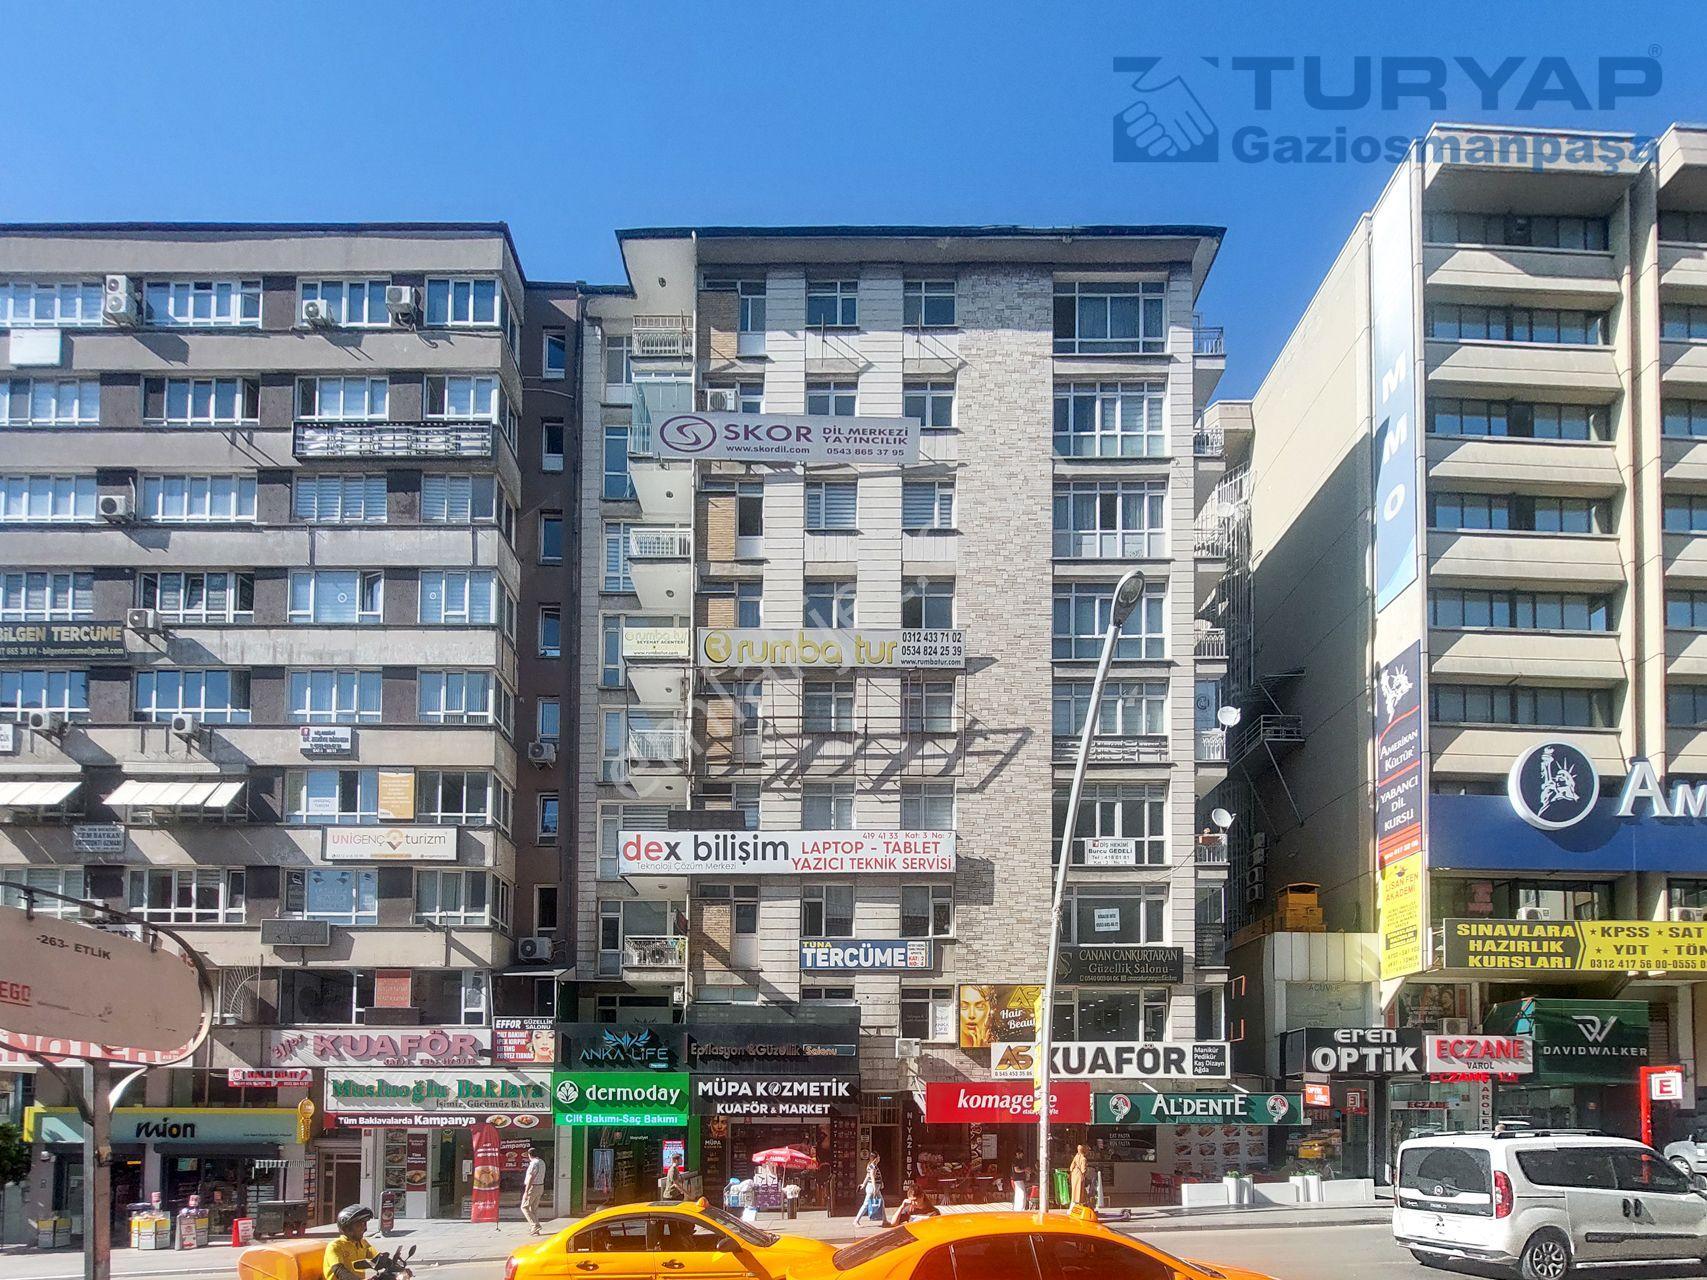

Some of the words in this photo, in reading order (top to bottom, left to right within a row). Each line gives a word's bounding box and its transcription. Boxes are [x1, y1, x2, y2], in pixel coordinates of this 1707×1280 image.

[724, 424, 813, 443] SKOR
[822, 436, 908, 445] YAYINCILIK
[726, 445, 810, 454] www.skordil.com
[51, 625, 122, 642] TERCÜME
[635, 629, 671, 640] rumba
[902, 632, 921, 643] 0312
[923, 632, 938, 642] 433
[940, 632, 949, 642] 71
[951, 632, 962, 642] 02
[737, 631, 842, 664] rumba
[855, 634, 897, 664] tur
[901, 646, 921, 656] 0534
[923, 646, 938, 656] 824
[940, 646, 950, 656] 25
[951, 646, 962, 656] 39
[901, 658, 962, 666] www.rumbatur.com
[1380, 774, 1419, 804] YABANCI
[1384, 808, 1414, 832] KURSU
[405, 833, 446, 845] turizm
[622, 834, 682, 862] dex
[693, 834, 789, 866] bilişim
[801, 841, 864, 855] LAPTOP
[883, 841, 941, 855] TABLET
[637, 862, 672, 871] Teknoloji
[674, 861, 704, 872] Çözüm
[705, 861, 737, 870] Merkezi
[792, 857, 844, 871] YAZICI
[849, 855, 897, 870] TEKNİK
[902, 855, 952, 870] SERVİSİ
[1456, 923, 1576, 938] SINAVLARA
[1600, 926, 1650, 938] KPSS
[1668, 926, 1704, 938] SAT
[36, 935, 70, 948] -263-
[1468, 940, 1564, 953] HAZIRLIK
[74, 943, 111, 960] ETLİK
[802, 943, 906, 967] TERCÜME
[1079, 949, 1111, 961] CANAN
[1112, 949, 1178, 962] CANKURTARAN
[1613, 944, 1649, 955] YDT
[1468, 955, 1572, 969] KURSLARI
[1590, 959, 1615, 969] 0312
[1618, 959, 1636, 969] 417
[1640, 959, 1652, 969] 56
[1088, 963, 1132, 975] Güzellik
[1134, 963, 1168, 974] Salonu
[1000, 1008, 1022, 1019] Hair
[495, 1019, 521, 1029] EFFOR
[313, 1030, 479, 1057] KUAFÖR
[1435, 1039, 1526, 1060] ECZANE
[579, 1047, 625, 1060] ANKA
[691, 1043, 745, 1059] Epilasyon
[805, 1046, 838, 1056] Salonu
[1467, 1062, 1494, 1070] VAROL
[331, 1078, 450, 1104] Musluoğlu
[456, 1078, 546, 1099] Baklava
[698, 1078, 753, 1097] MÜPA
[756, 1077, 850, 1097] KOZMETİK
[1659, 1079, 1673, 1094] E
[585, 1085, 681, 1105] dermoday
[958, 1088, 1057, 1115] komagee
[467, 1100, 510, 1108] Gücümüz
[511, 1100, 545, 1108] Baklava
[716, 1101, 768, 1114] KUAFÖR
[779, 1104, 830, 1114] MARKET
[1408, 1101, 1449, 1109] ECZANE
[338, 1117, 357, 1125] Tüm
[358, 1117, 413, 1125] Baklavalarda
[414, 1115, 476, 1127] Kampanya
[565, 1114, 583, 1124] Cilt
[644, 1114, 678, 1124] Bakımı
[136, 1117, 196, 1139] mion
